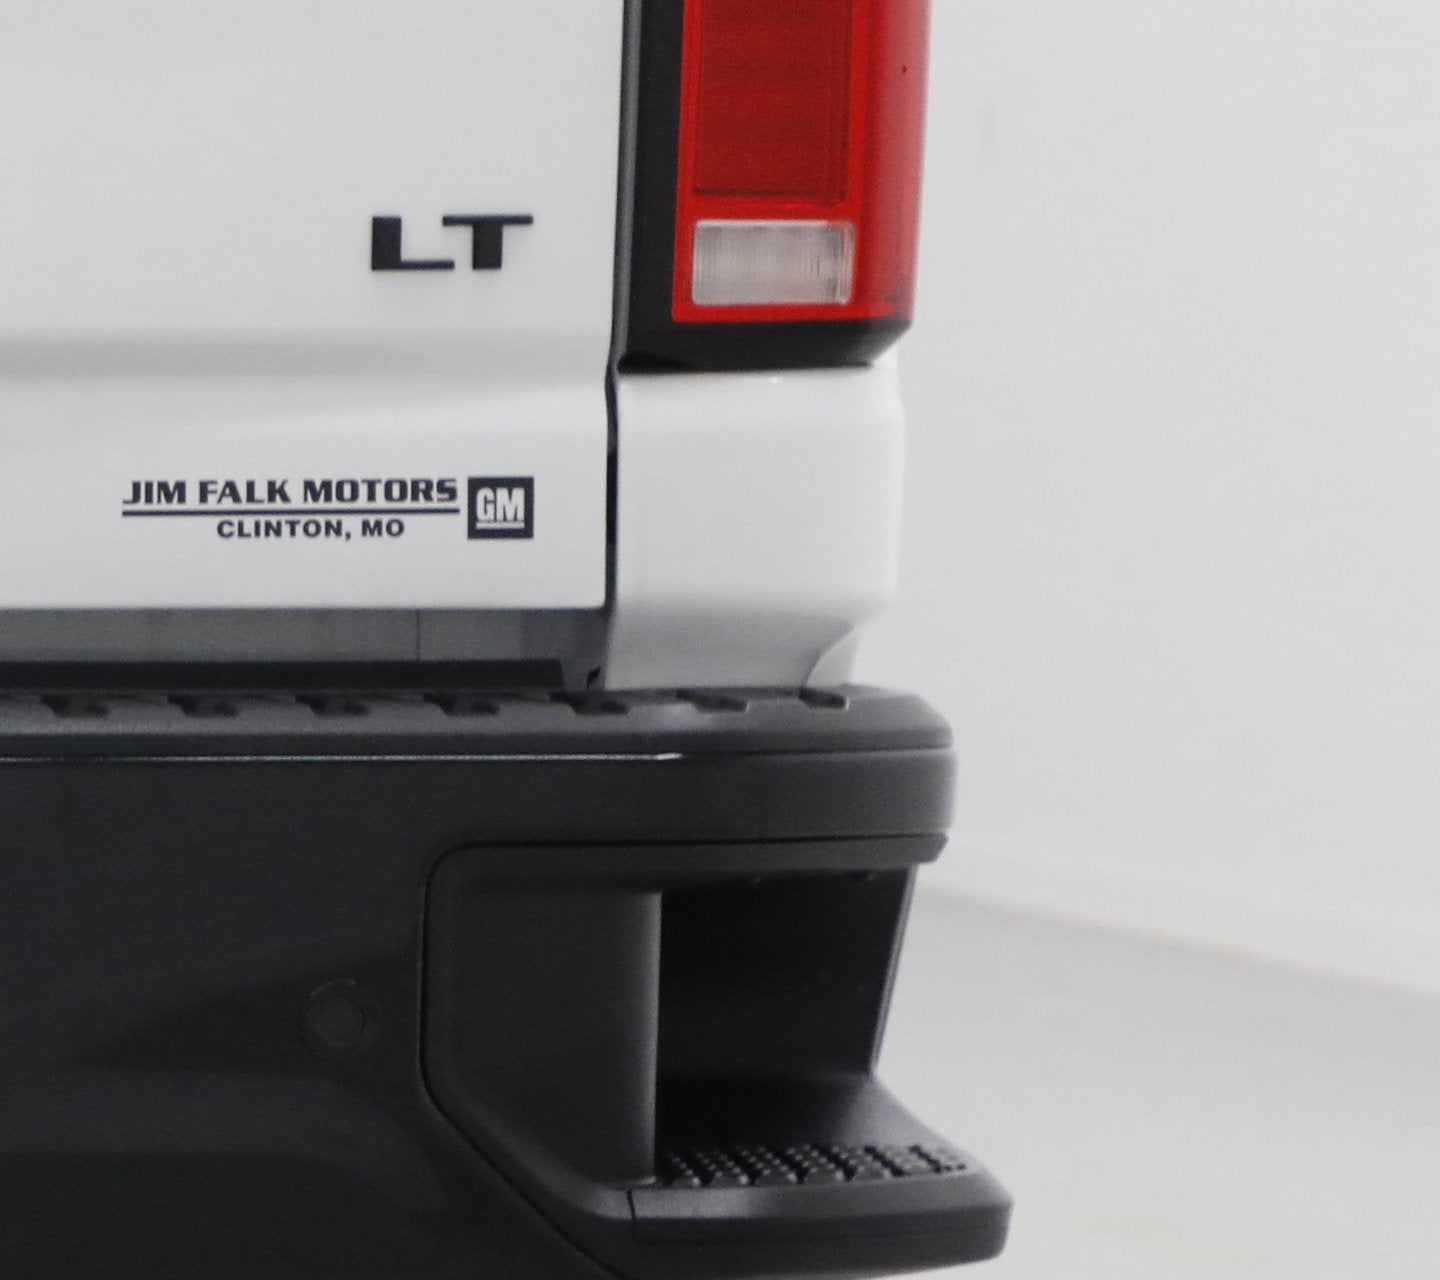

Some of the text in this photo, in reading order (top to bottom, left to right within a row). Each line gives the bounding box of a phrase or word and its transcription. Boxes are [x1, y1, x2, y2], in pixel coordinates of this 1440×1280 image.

[370, 214, 534, 272] LT
[122, 477, 459, 506] JIM FALK MOTORS
[215, 518, 406, 542] CLINTON, MO
